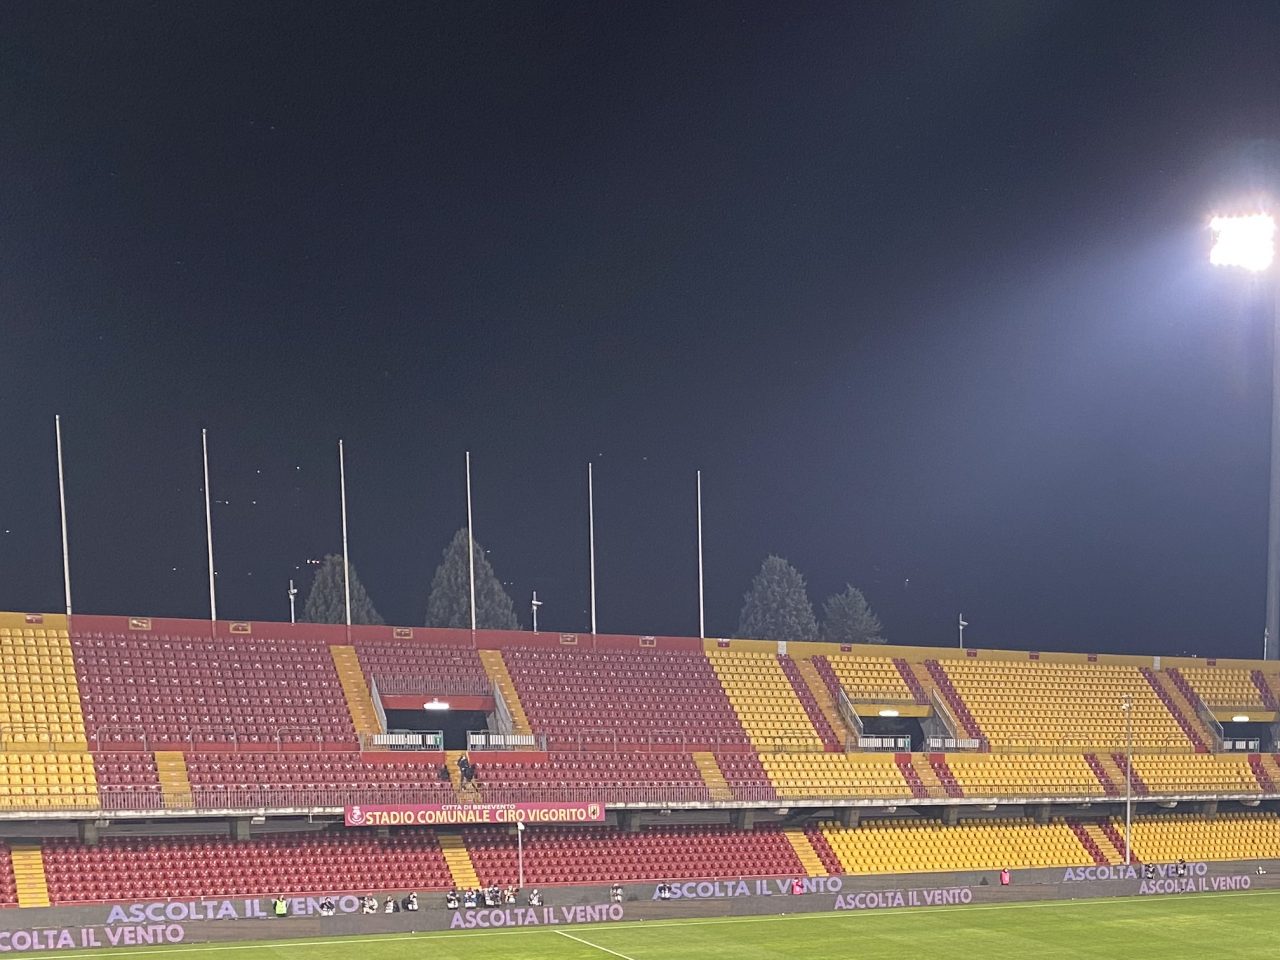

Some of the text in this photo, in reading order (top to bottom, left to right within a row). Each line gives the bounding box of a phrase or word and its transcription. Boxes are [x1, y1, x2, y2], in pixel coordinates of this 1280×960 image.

[365, 808, 586, 825] STADIO COMUNALE CIRO VIGORITO
[1063, 865, 1137, 881] ASCOLTA
[755, 879, 772, 896] IL
[776, 876, 842, 895] VNTO
[1139, 875, 1250, 894] ASCOLTA IL VENTO
[834, 888, 972, 910] ASCOLTA IL VENTO
[106, 900, 237, 924] ASCOLTA
[245, 899, 267, 917] IL
[450, 904, 624, 929] ASCOLTA IL VENTO
[81, 928, 102, 948] IL
[104, 923, 184, 946] VENTO
